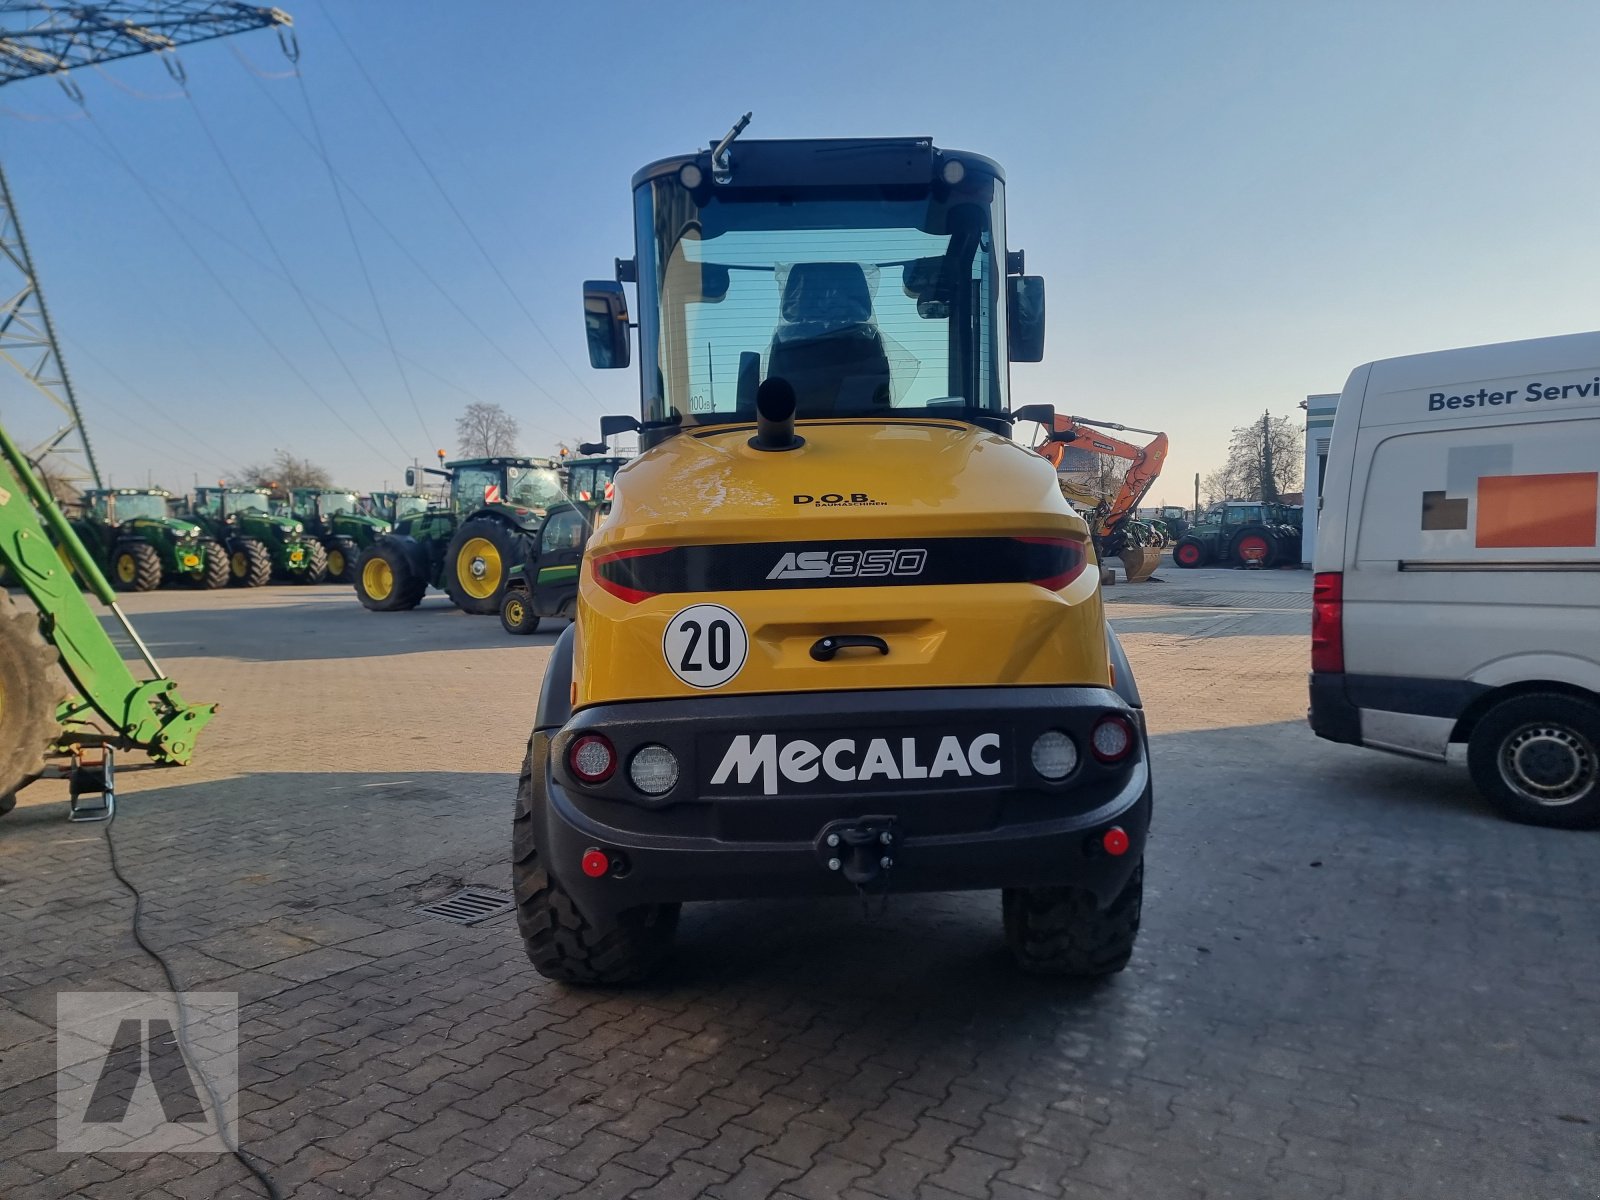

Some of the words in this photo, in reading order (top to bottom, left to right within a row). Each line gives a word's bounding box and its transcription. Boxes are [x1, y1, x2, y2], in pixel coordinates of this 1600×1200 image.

[1428, 388, 1518, 411] Bester
[1525, 376, 1600, 402] Servi
[793, 493, 876, 504] D.O.B.
[765, 548, 928, 580] AS850
[679, 619, 731, 671] 20
